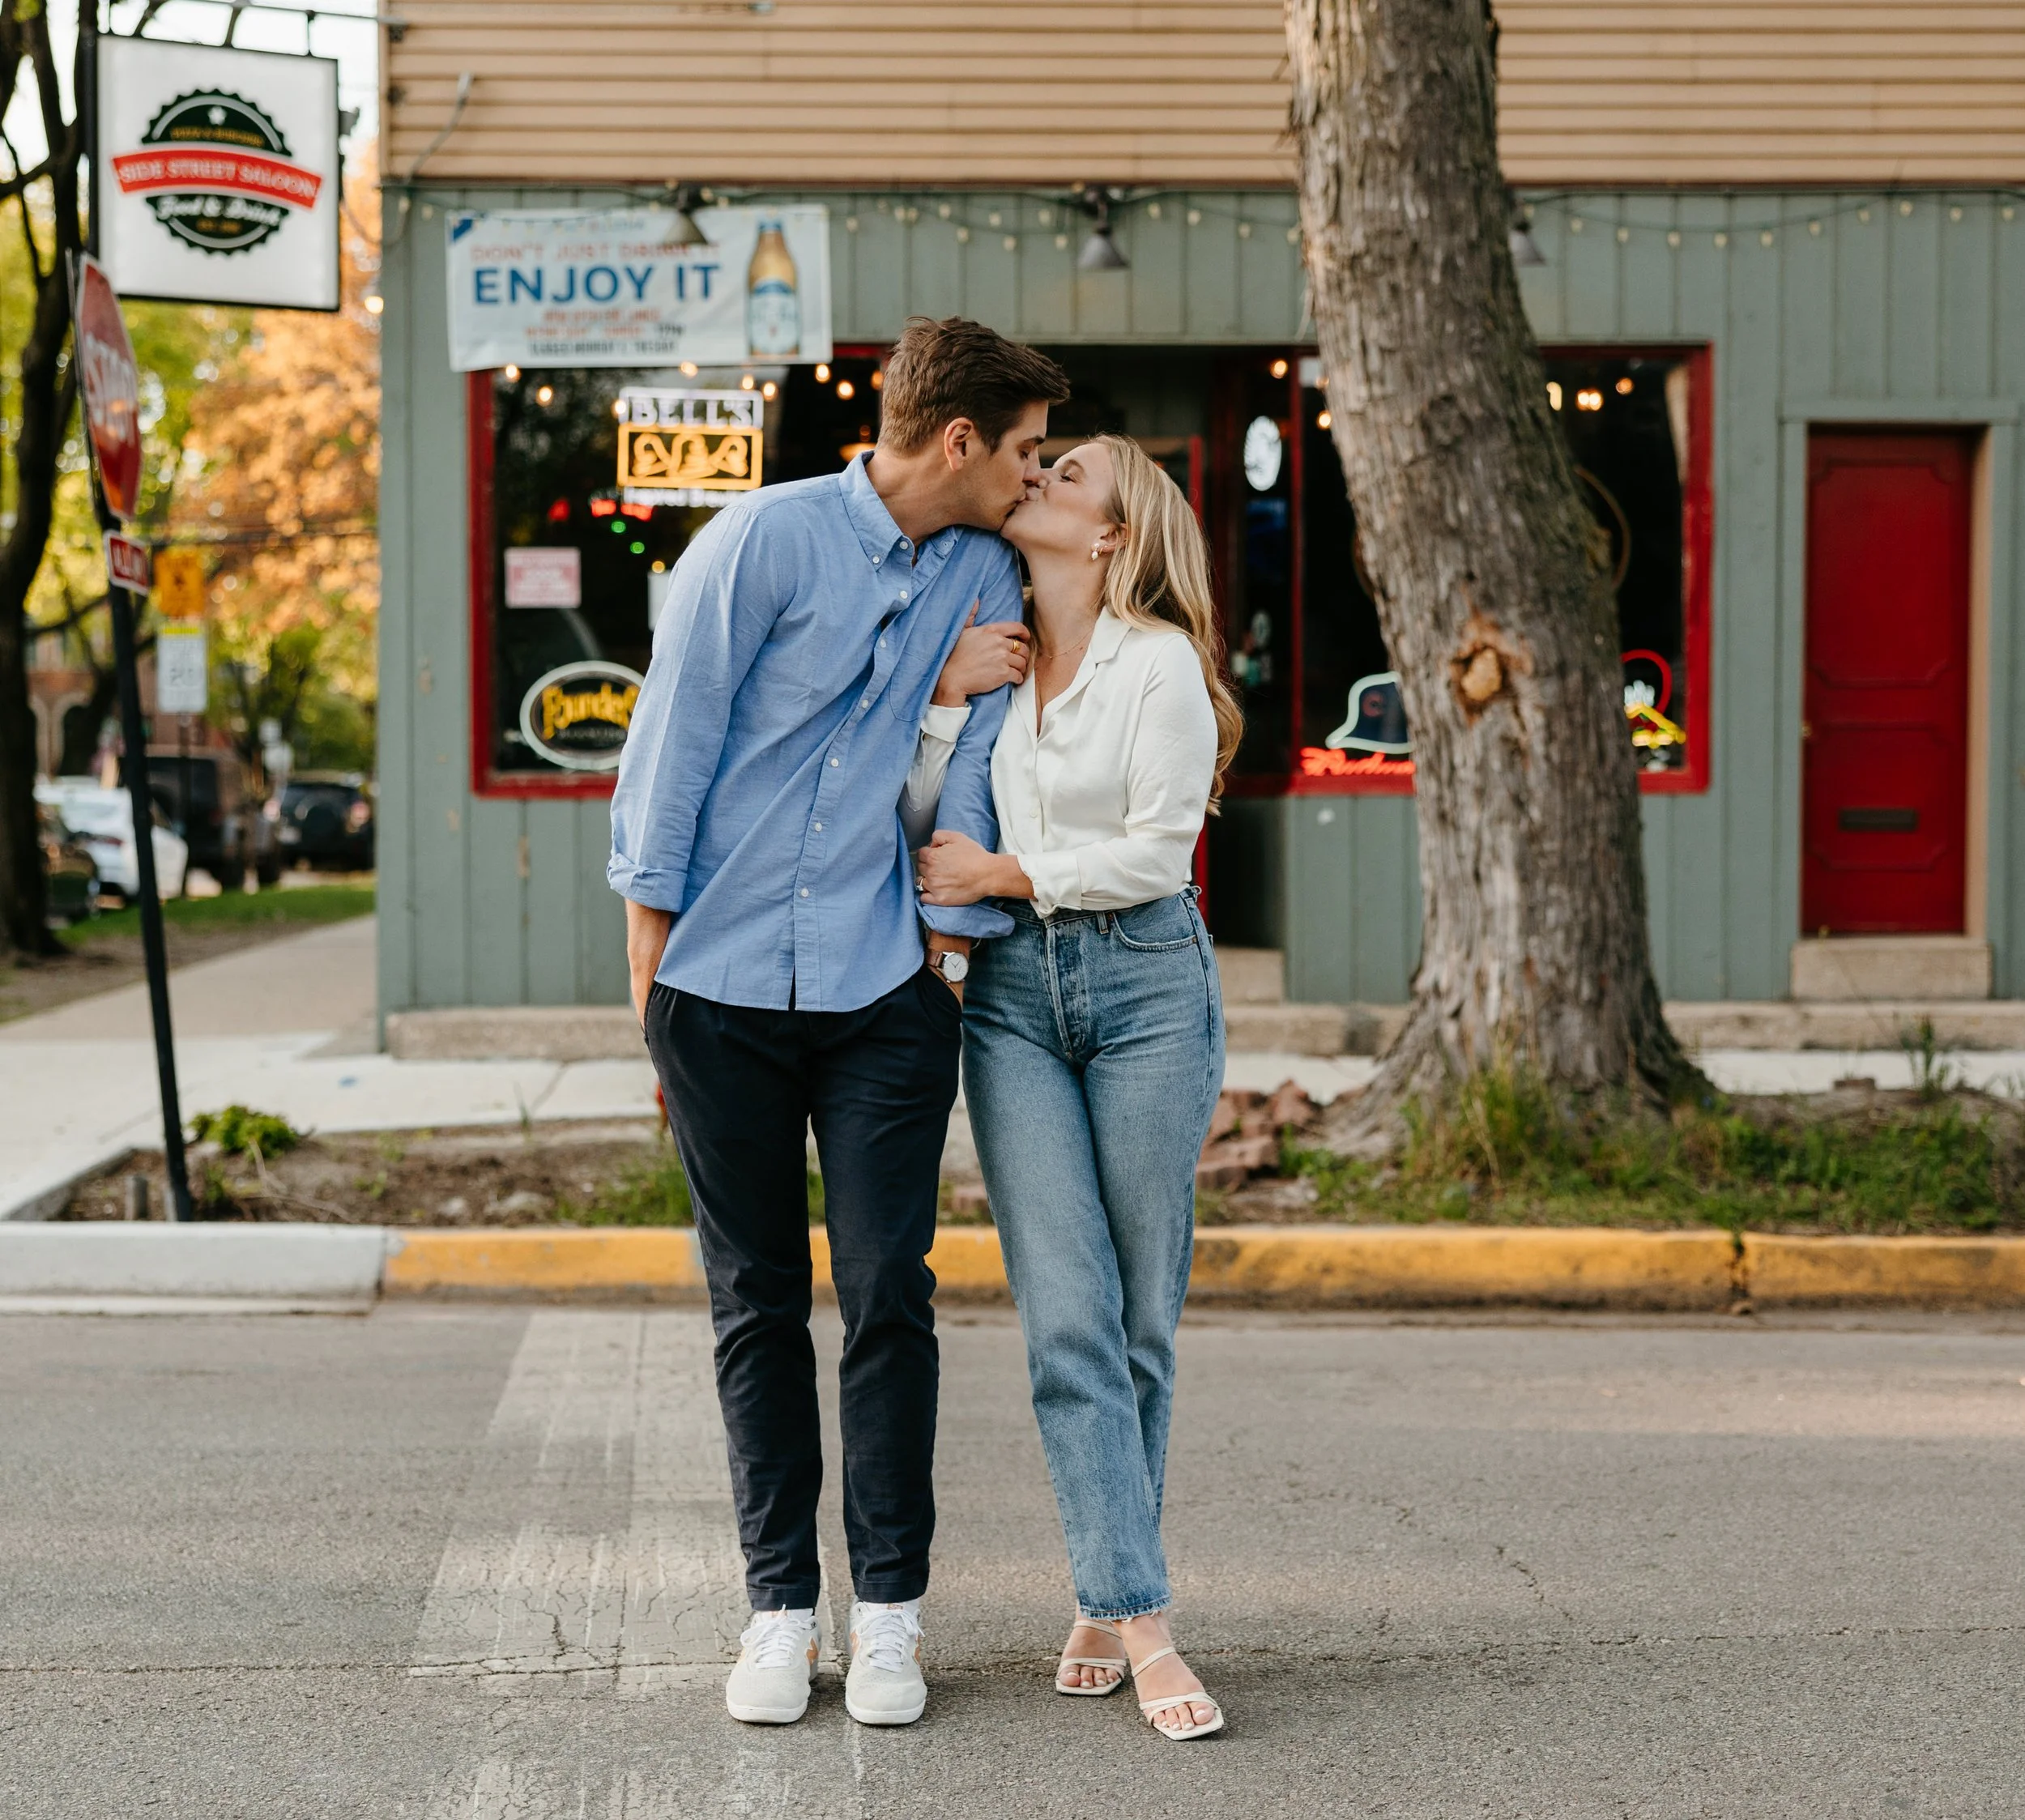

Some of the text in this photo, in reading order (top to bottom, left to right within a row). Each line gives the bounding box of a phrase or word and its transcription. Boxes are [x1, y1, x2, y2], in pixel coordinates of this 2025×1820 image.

[119, 159, 317, 198] SIDE STREET SALOON
[474, 263, 721, 305] ENJOY IT
